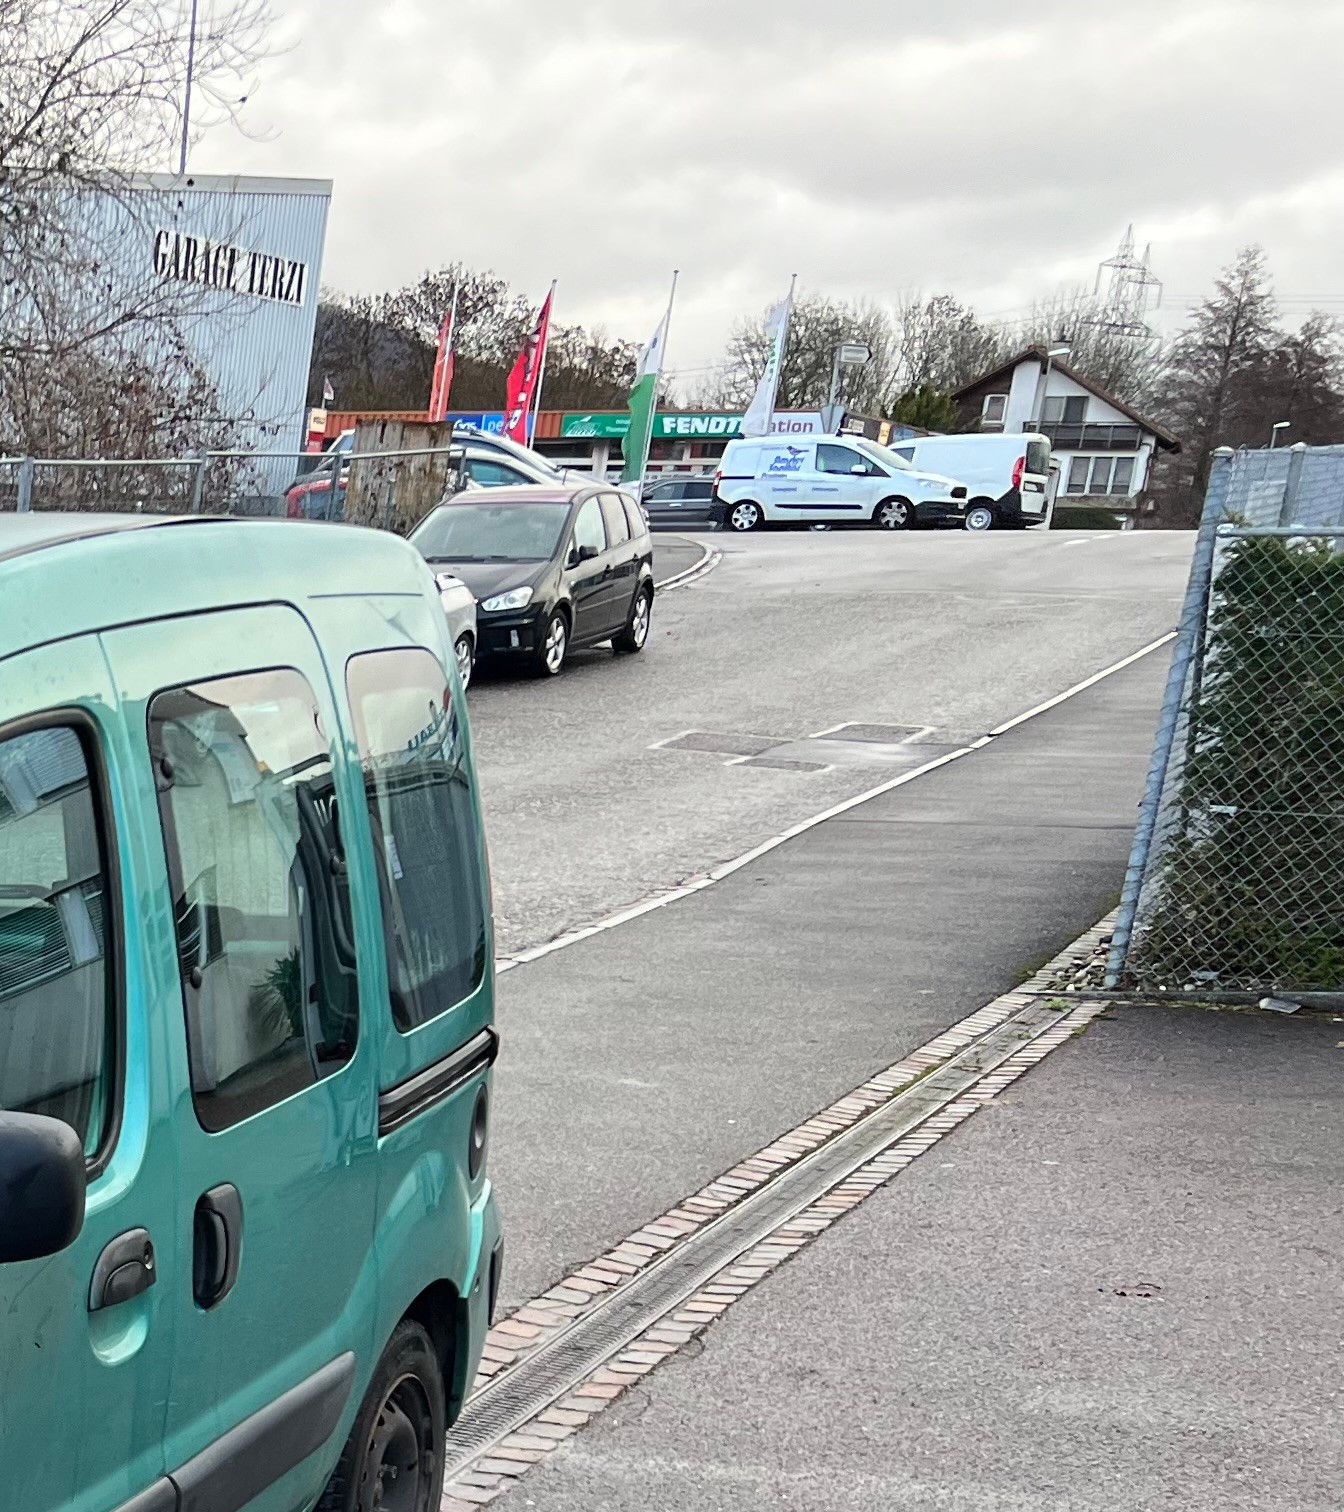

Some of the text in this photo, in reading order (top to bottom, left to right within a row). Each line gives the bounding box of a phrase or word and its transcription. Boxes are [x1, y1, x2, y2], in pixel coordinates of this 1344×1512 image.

[154, 230, 306, 305] GARAGE TERZI
[662, 416, 744, 434] FENDT
